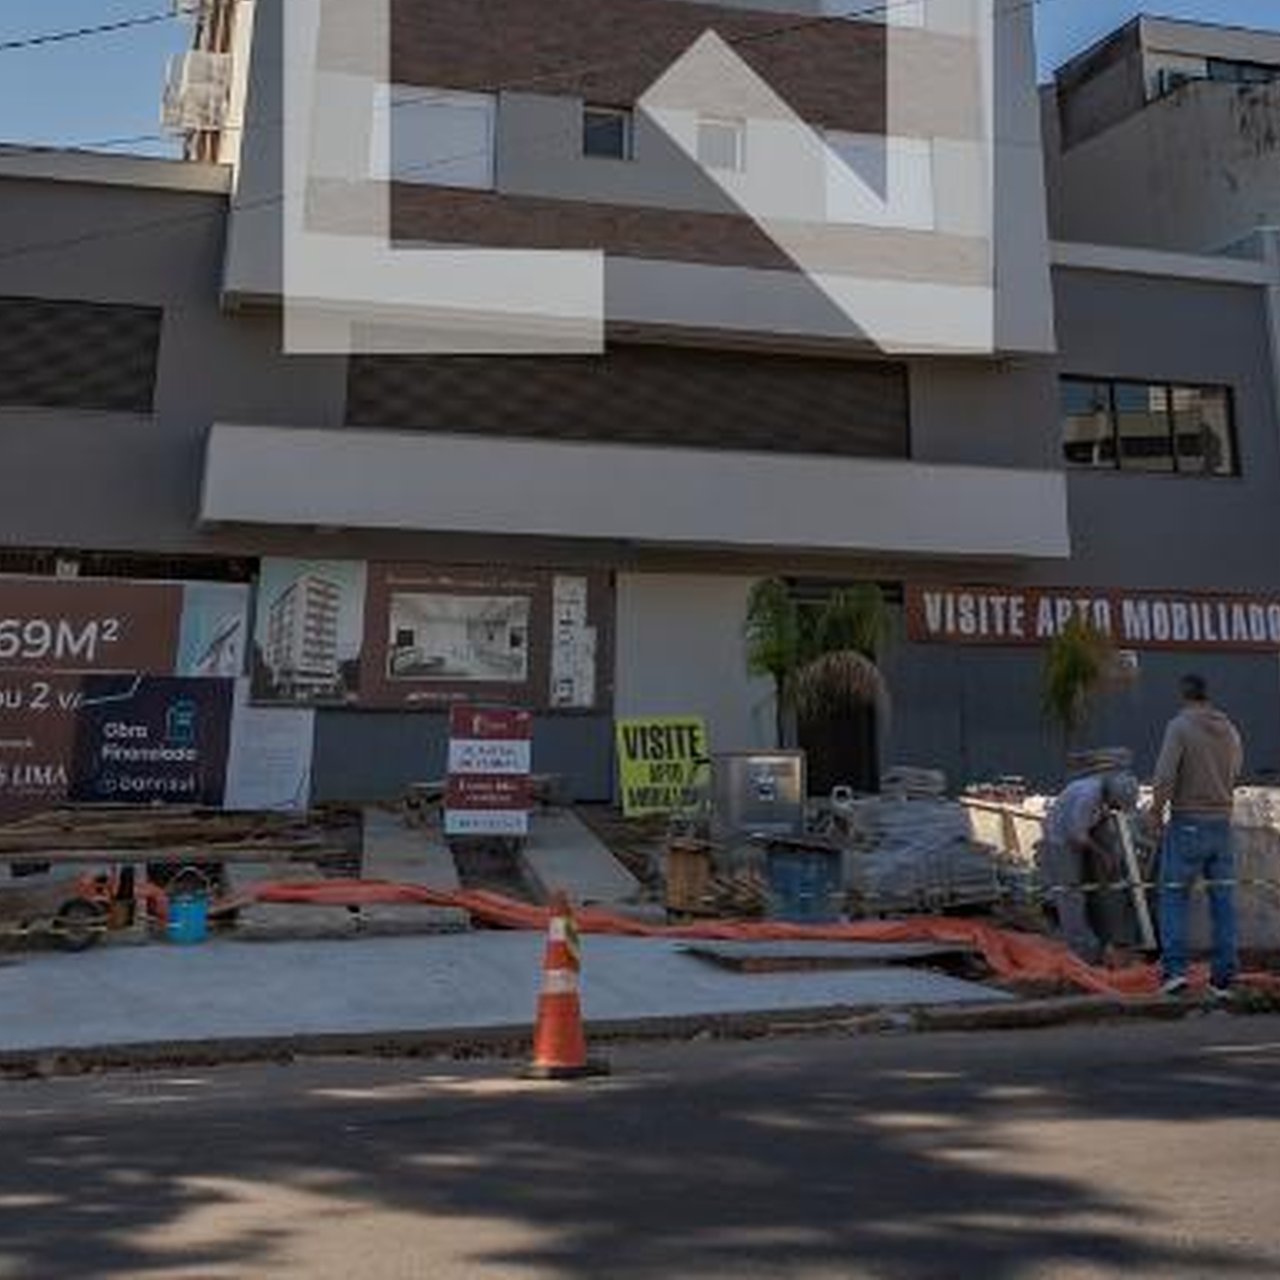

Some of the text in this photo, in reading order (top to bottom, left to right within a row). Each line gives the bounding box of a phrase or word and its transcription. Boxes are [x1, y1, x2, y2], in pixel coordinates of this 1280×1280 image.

[923, 592, 1025, 637] VISITE
[1036, 595, 1111, 639] APTO
[29, 681, 52, 710] 2
[622, 723, 702, 760] VISITE
[11, 762, 69, 787] LIMA
